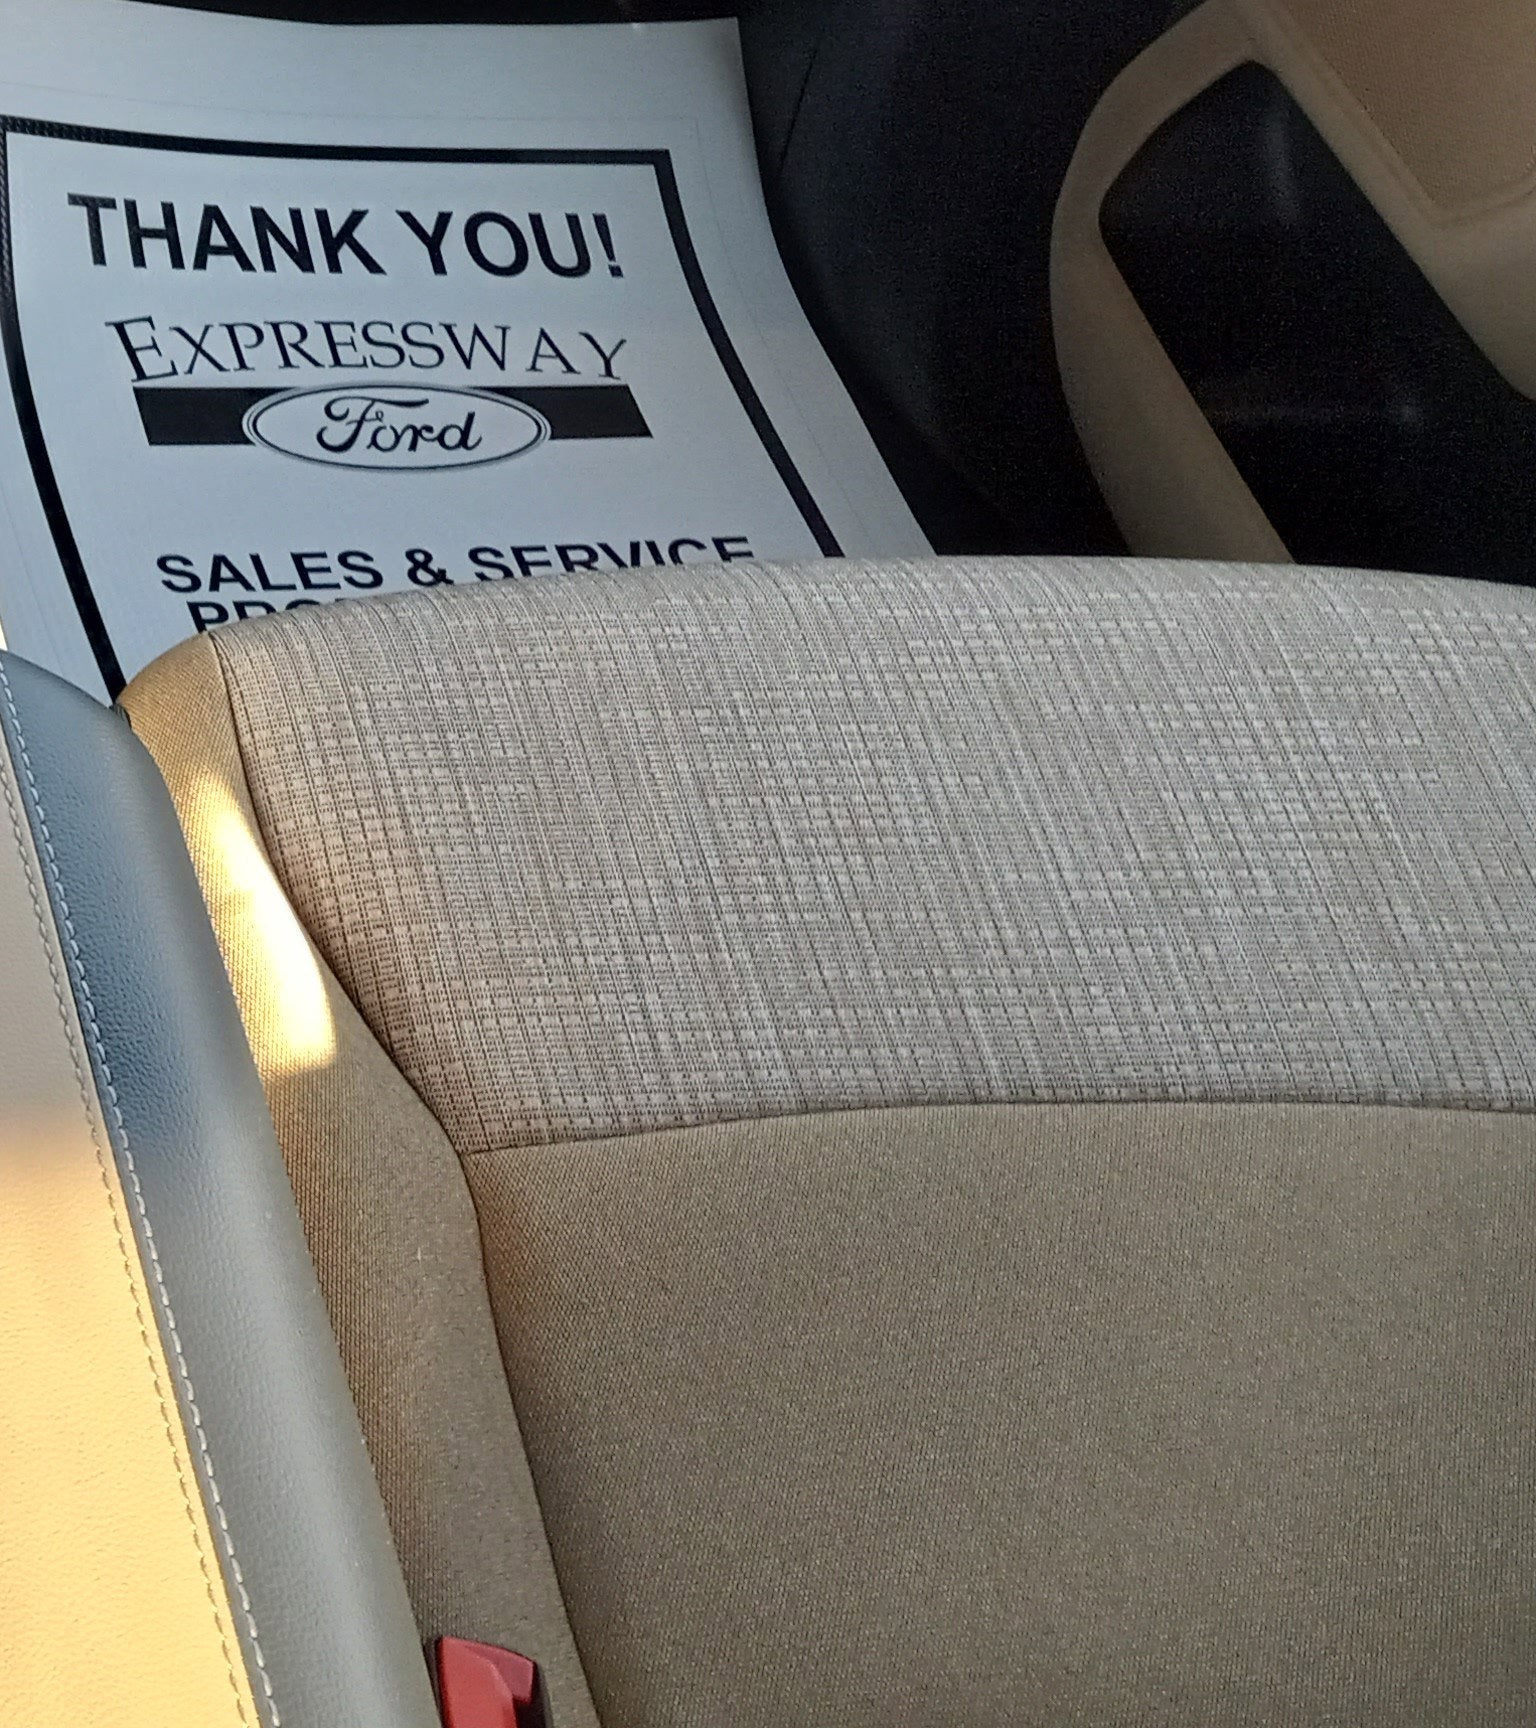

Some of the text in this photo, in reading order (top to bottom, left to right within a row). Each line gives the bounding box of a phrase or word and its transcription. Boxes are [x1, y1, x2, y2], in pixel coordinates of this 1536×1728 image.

[67, 193, 626, 280] THANK YOU!
[104, 315, 628, 383] EXPRESSWAY
[316, 395, 482, 454] Ford
[156, 549, 384, 594] SALES
[406, 547, 455, 587] &
